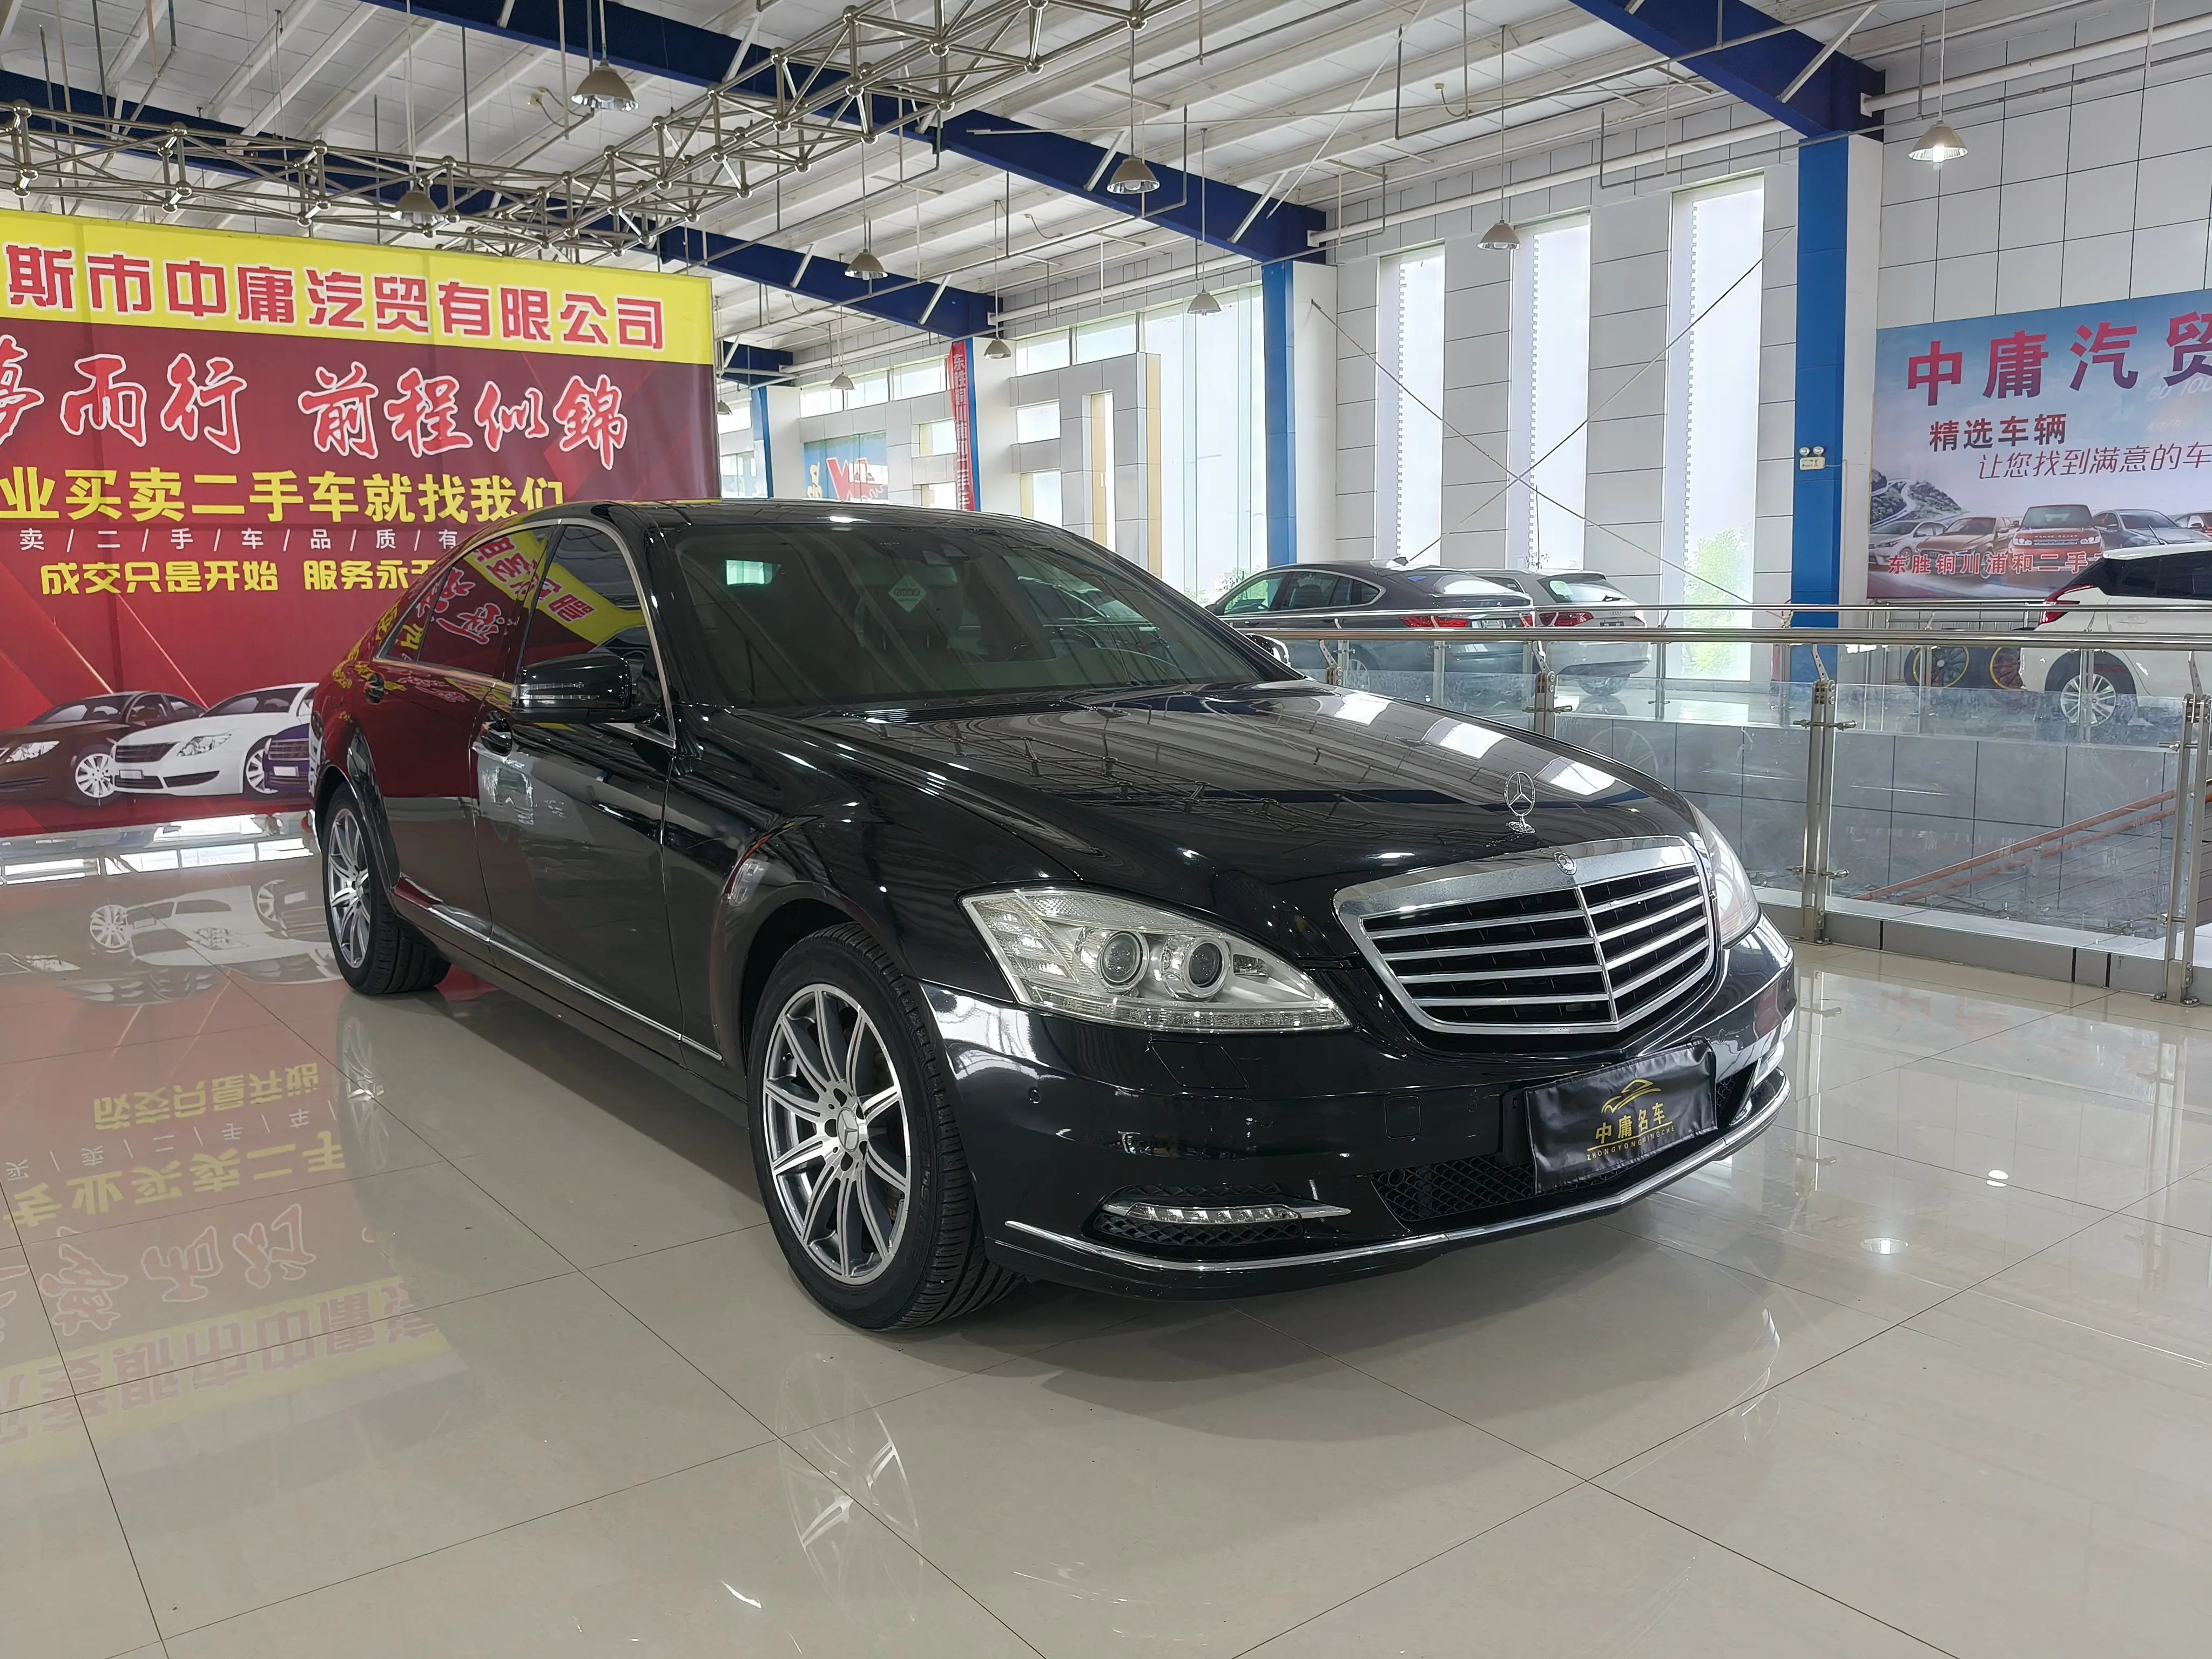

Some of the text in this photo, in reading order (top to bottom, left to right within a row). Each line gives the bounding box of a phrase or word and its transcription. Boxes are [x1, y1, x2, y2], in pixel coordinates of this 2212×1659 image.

[4, 243, 665, 351] 斯市中庸汽贸有限公司
[1907, 312, 2212, 407] 中庸汽贸
[1929, 413, 2067, 453] 精选车辆
[1979, 442, 2212, 480] 让您找到满意的车
[0, 466, 563, 523] 业买卖二手车就找我们
[41, 561, 279, 595] 成交只是开始
[1586, 1125, 1675, 1161] ZHONGYONGMINGCHE
[1595, 1102, 1665, 1144] 中庸名车
